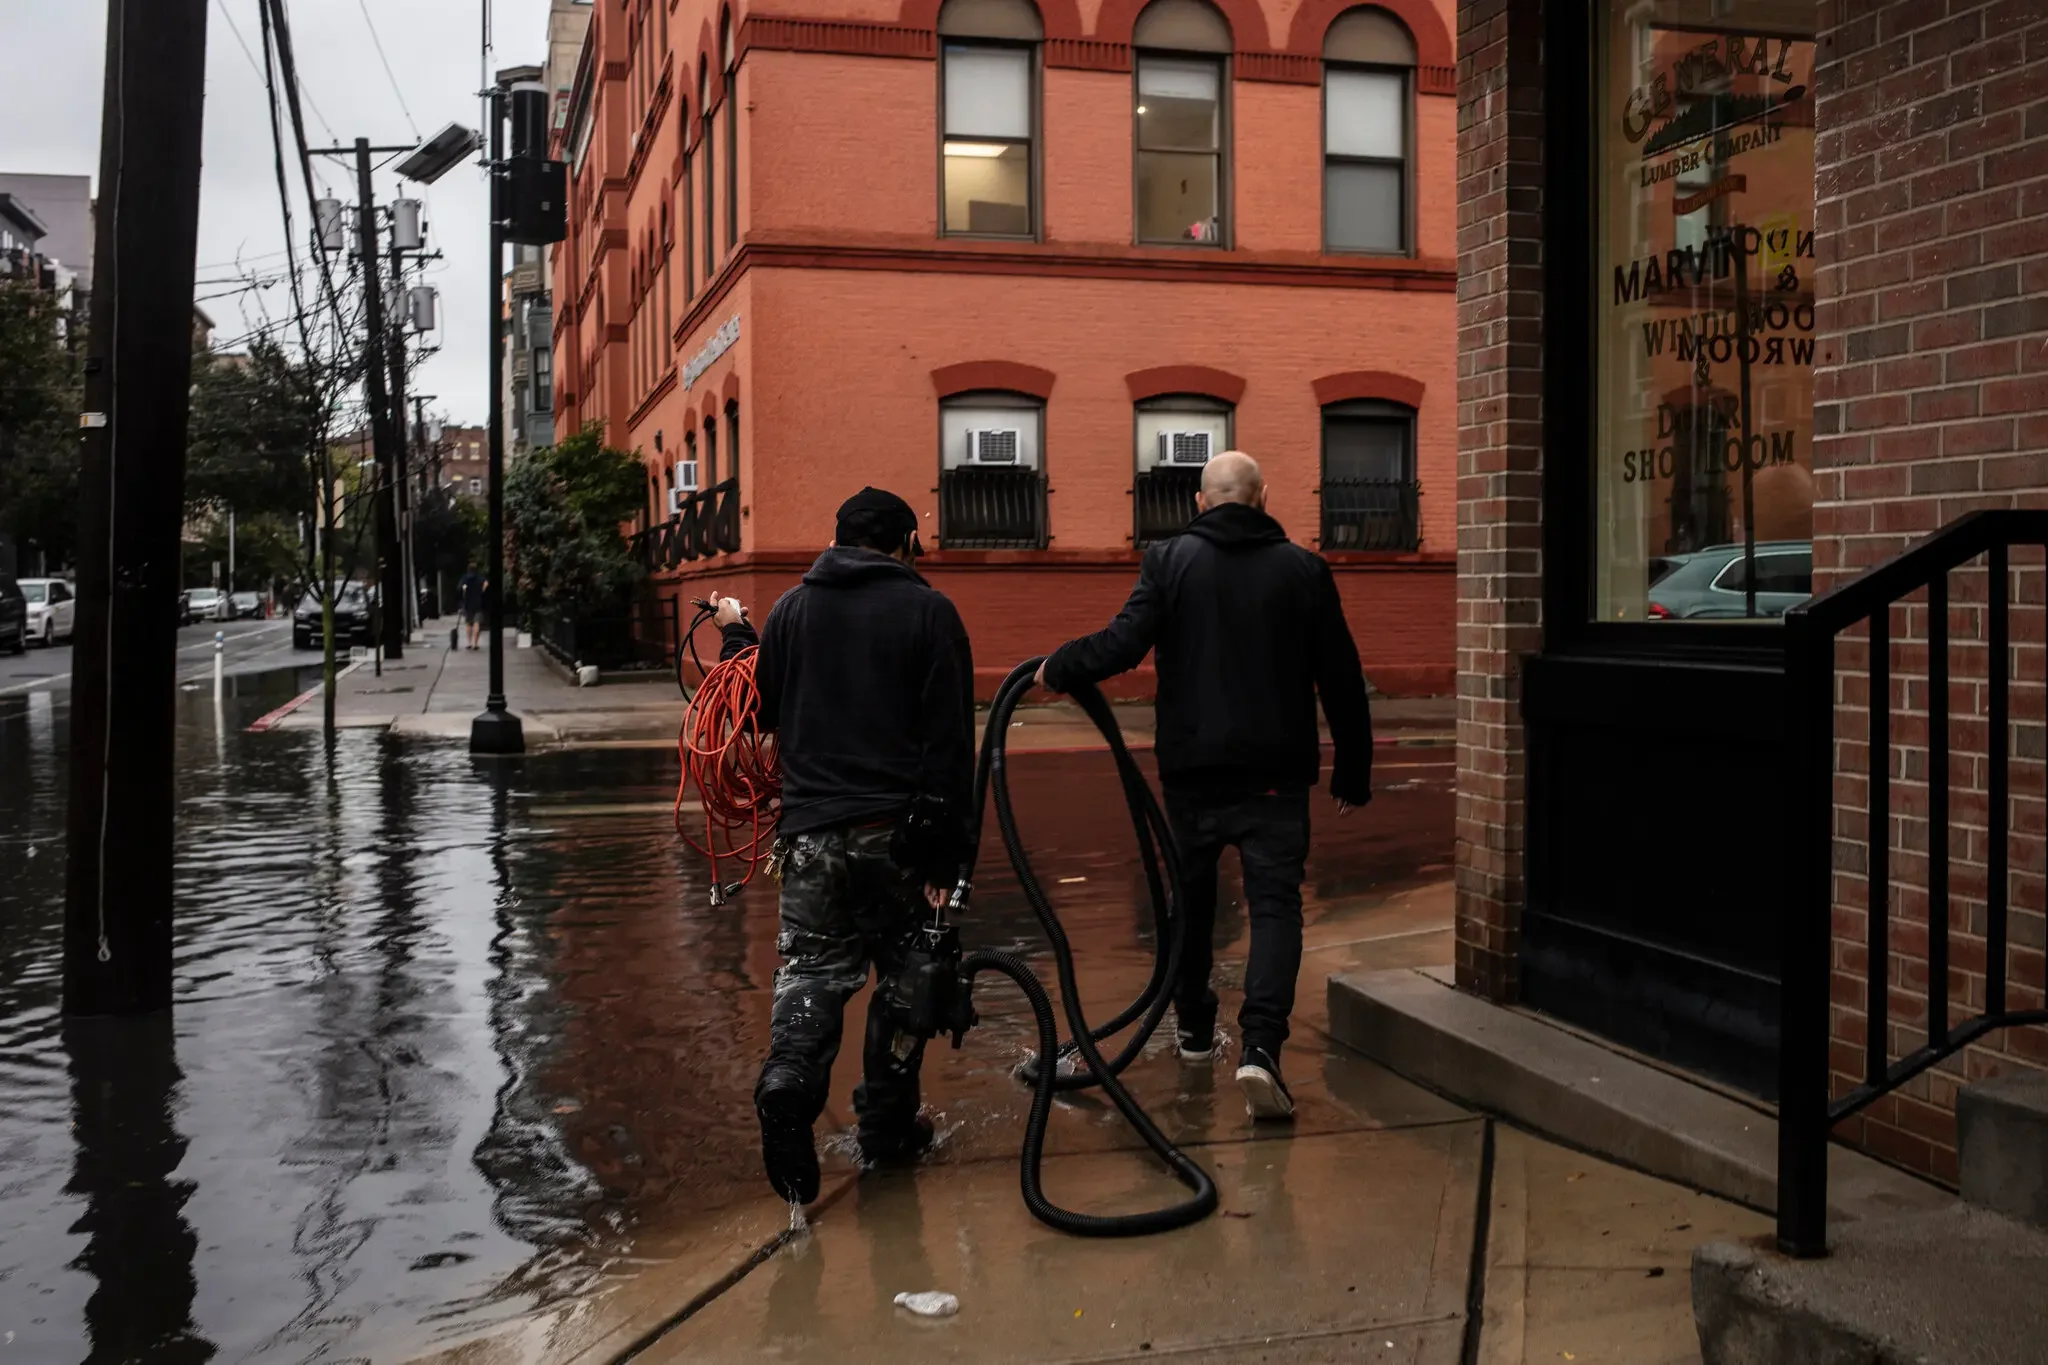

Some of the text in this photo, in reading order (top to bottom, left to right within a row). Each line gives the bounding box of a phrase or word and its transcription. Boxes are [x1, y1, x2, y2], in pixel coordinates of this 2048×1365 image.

[1622, 36, 1794, 143] GENERAL
[1640, 122, 1784, 188] LUMBER COMPANY
[1614, 234, 1746, 306] MARVIN
[1657, 395, 1741, 440] DOR
[1623, 430, 1796, 483] SHOOOM
